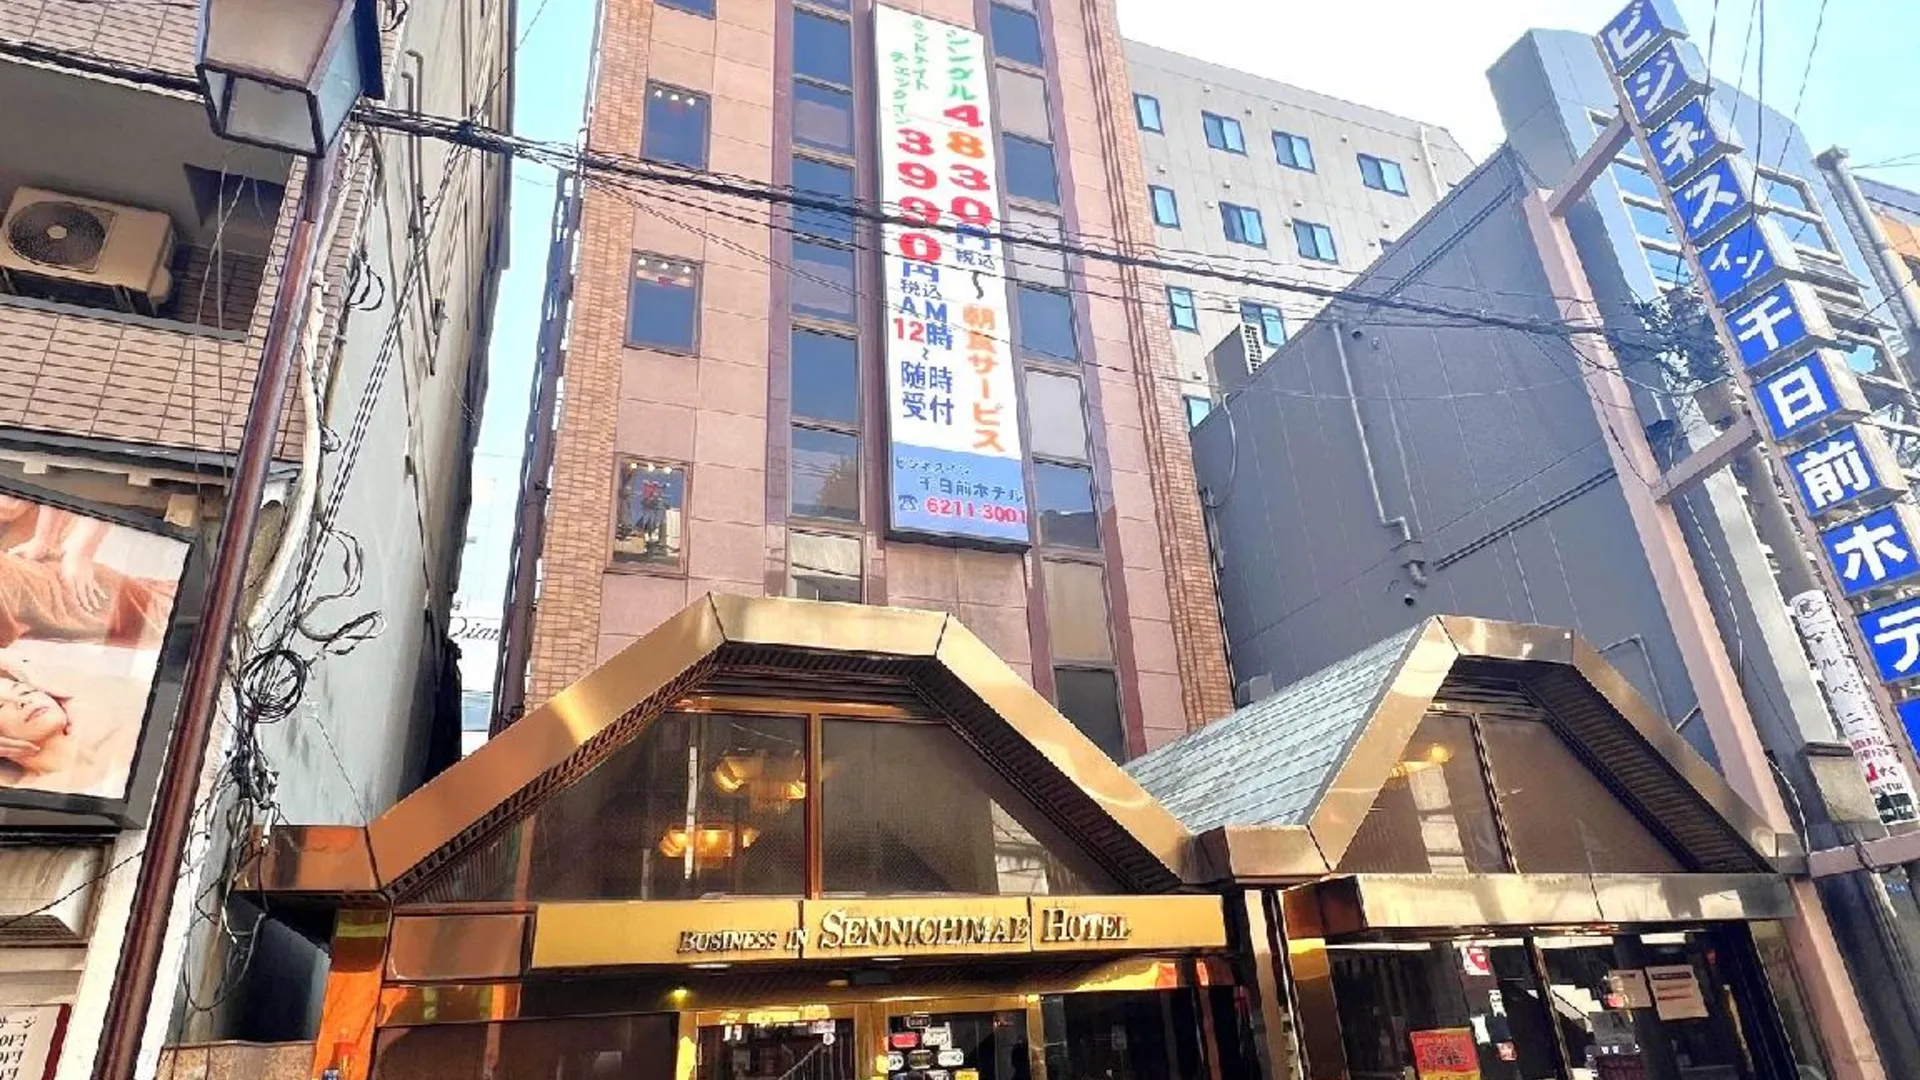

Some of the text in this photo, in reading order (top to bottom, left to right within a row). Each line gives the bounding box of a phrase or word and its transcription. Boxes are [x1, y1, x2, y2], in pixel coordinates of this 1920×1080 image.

[919, 475, 1025, 503] 千日前ホテル
[678, 906, 1133, 953] BUSINESS IN SENNICHIMAE HOTEL
